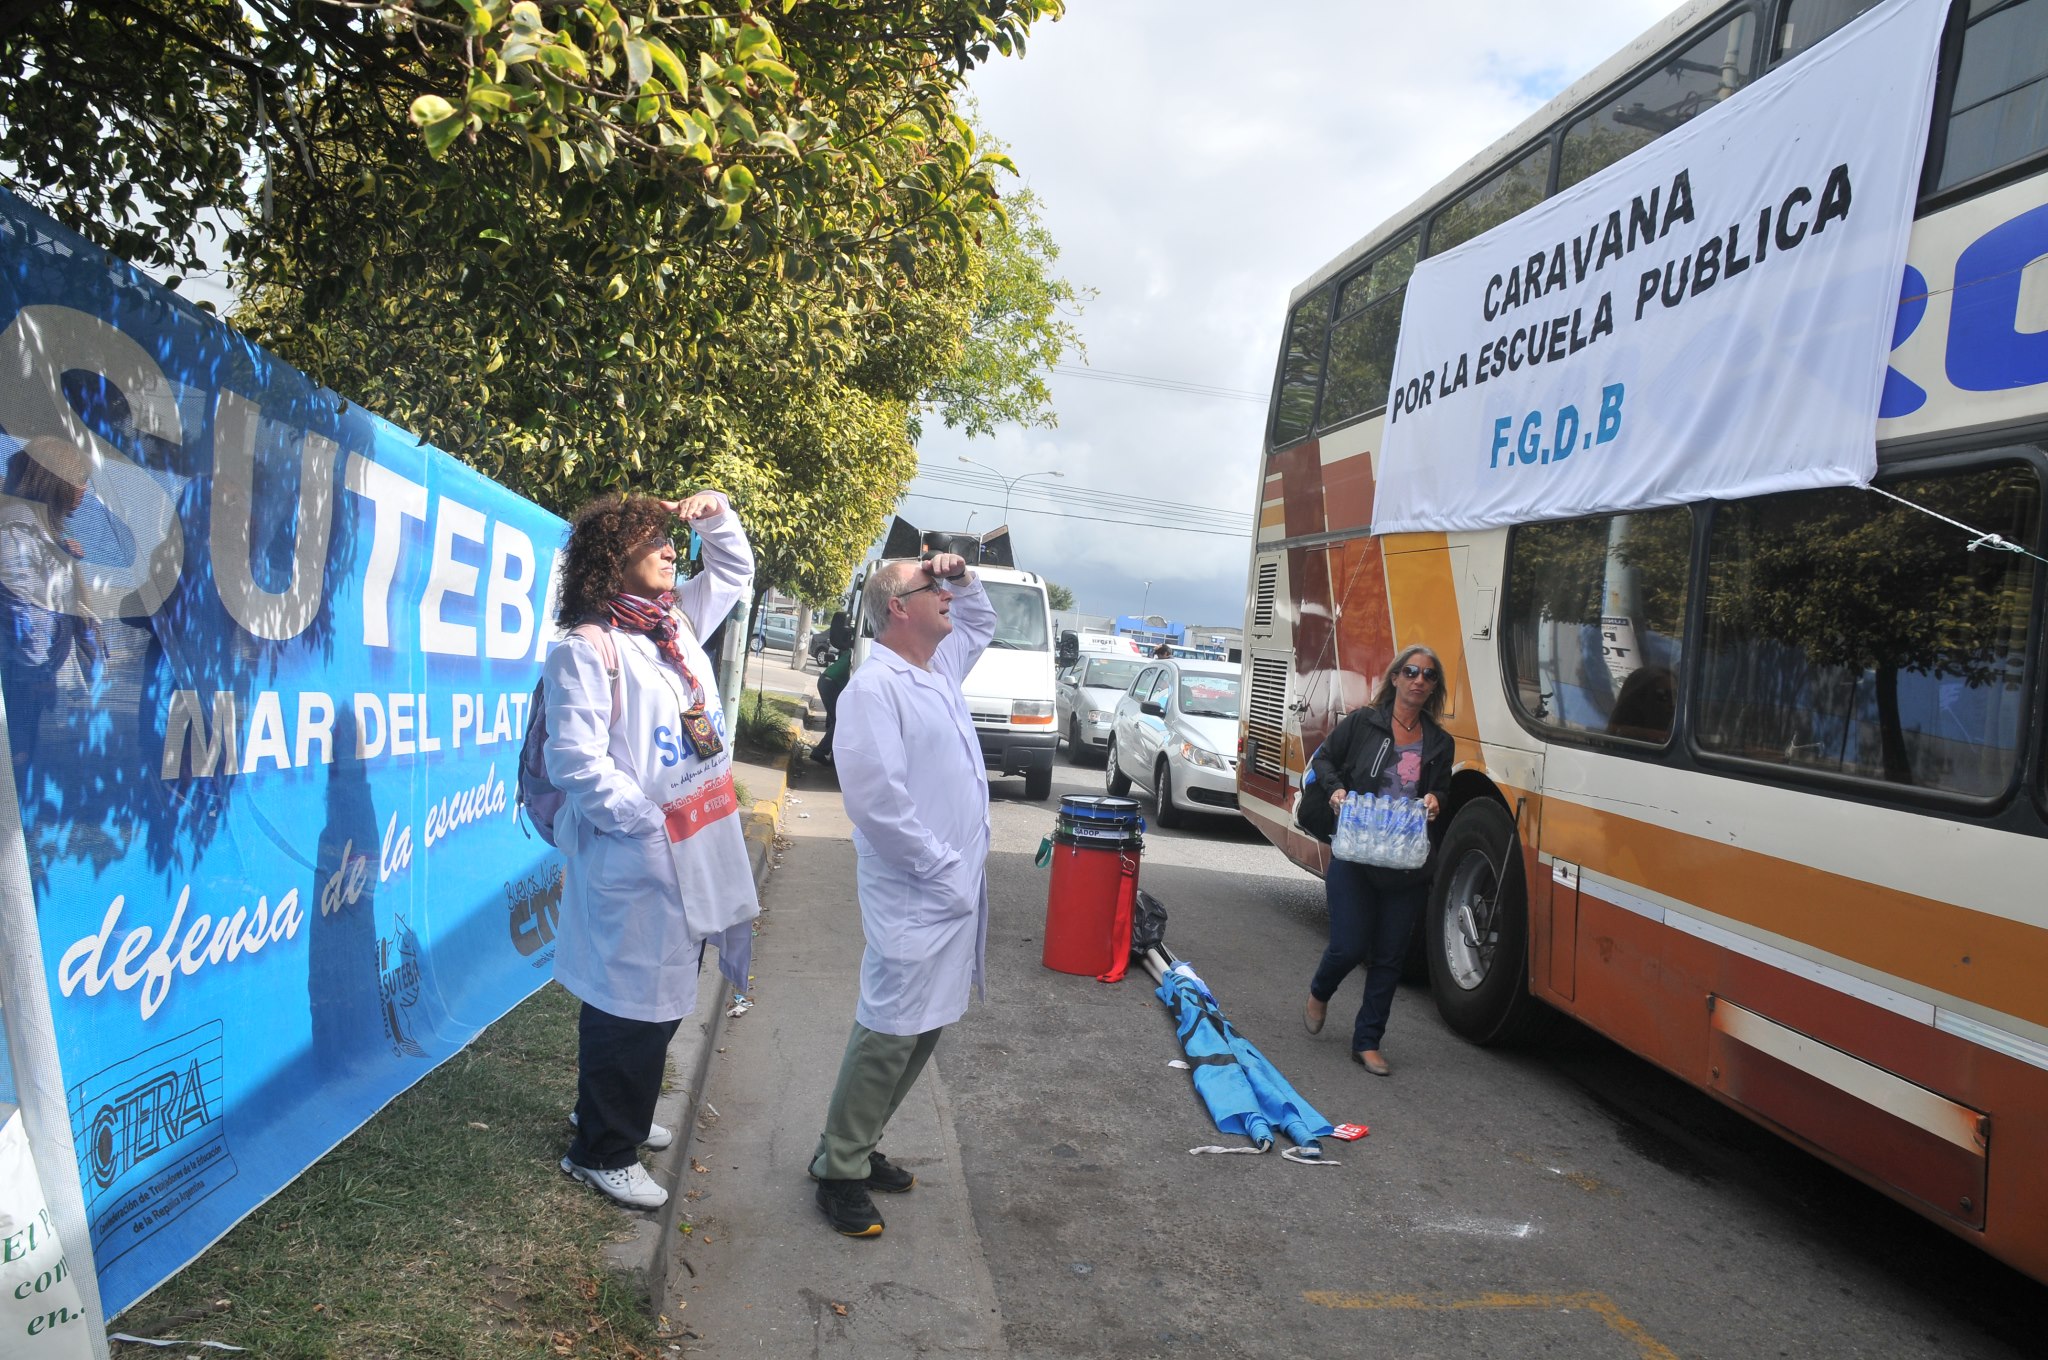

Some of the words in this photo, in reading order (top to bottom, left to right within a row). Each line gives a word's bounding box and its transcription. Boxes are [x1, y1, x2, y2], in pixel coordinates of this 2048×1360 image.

[1483, 168, 1696, 322] CARAVANA
[1392, 371, 1434, 424] POR
[1439, 352, 1468, 397] LA
[1475, 292, 1613, 385] ESCUELA
[1634, 163, 1853, 321] PUBLICA
[1490, 382, 1625, 469] F.G.D.B
[161, 690, 334, 780] MAR
[355, 693, 441, 760] DEL
[452, 693, 532, 748] PLAT
[1074, 828, 1100, 836] SADOP
[58, 885, 304, 1021] defensa
[322, 839, 366, 918] de
[380, 810, 413, 882] la
[424, 761, 506, 848] escuela
[382, 959, 422, 1000] SUTEBA
[90, 1058, 211, 1188] CTERA
[133, 1220, 145, 1234] de
[145, 1214, 154, 1226] la
[138, 1191, 151, 1204] de
[0, 1222, 38, 1265] El
